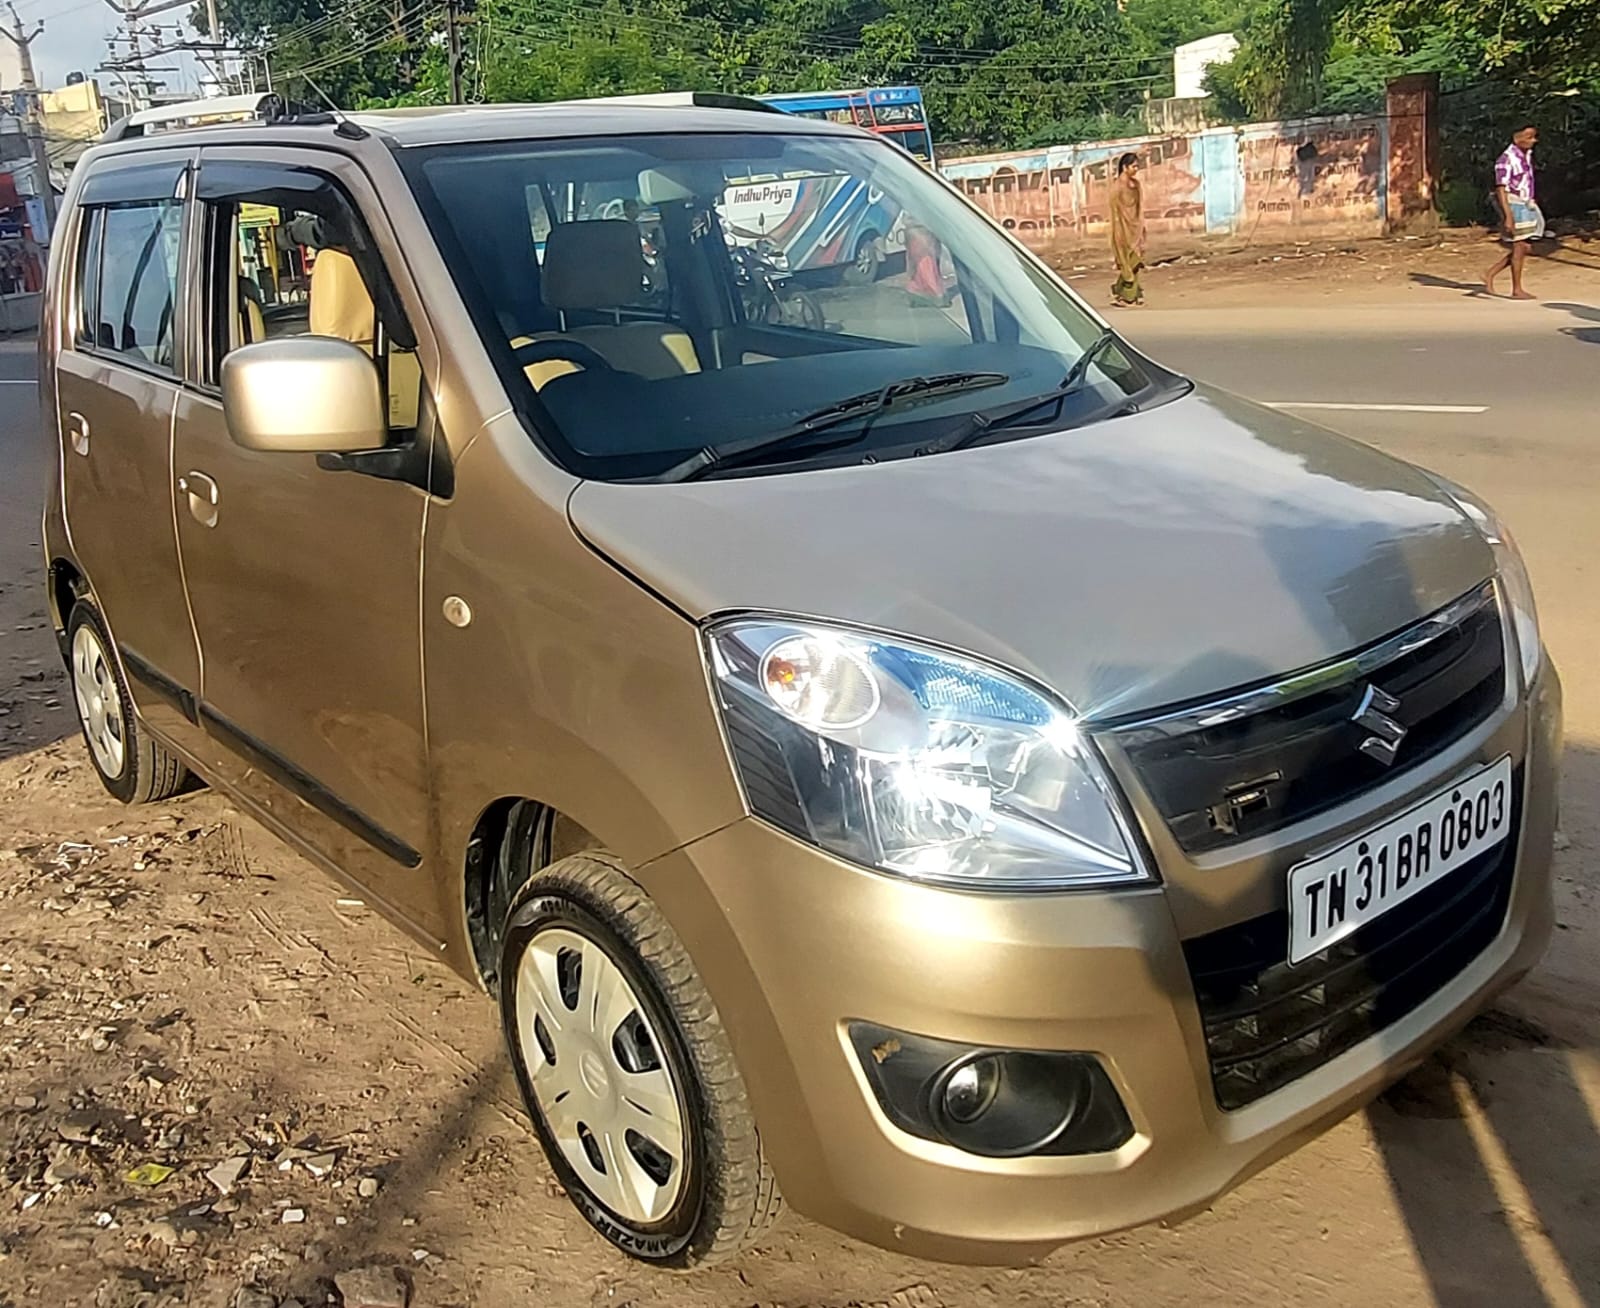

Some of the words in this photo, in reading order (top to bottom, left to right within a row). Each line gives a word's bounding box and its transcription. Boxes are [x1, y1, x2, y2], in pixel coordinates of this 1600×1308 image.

[1305, 867, 1348, 938] TN
[1355, 845, 1389, 911] 31
[1396, 823, 1432, 890] BR
[1440, 780, 1504, 860] 0803
